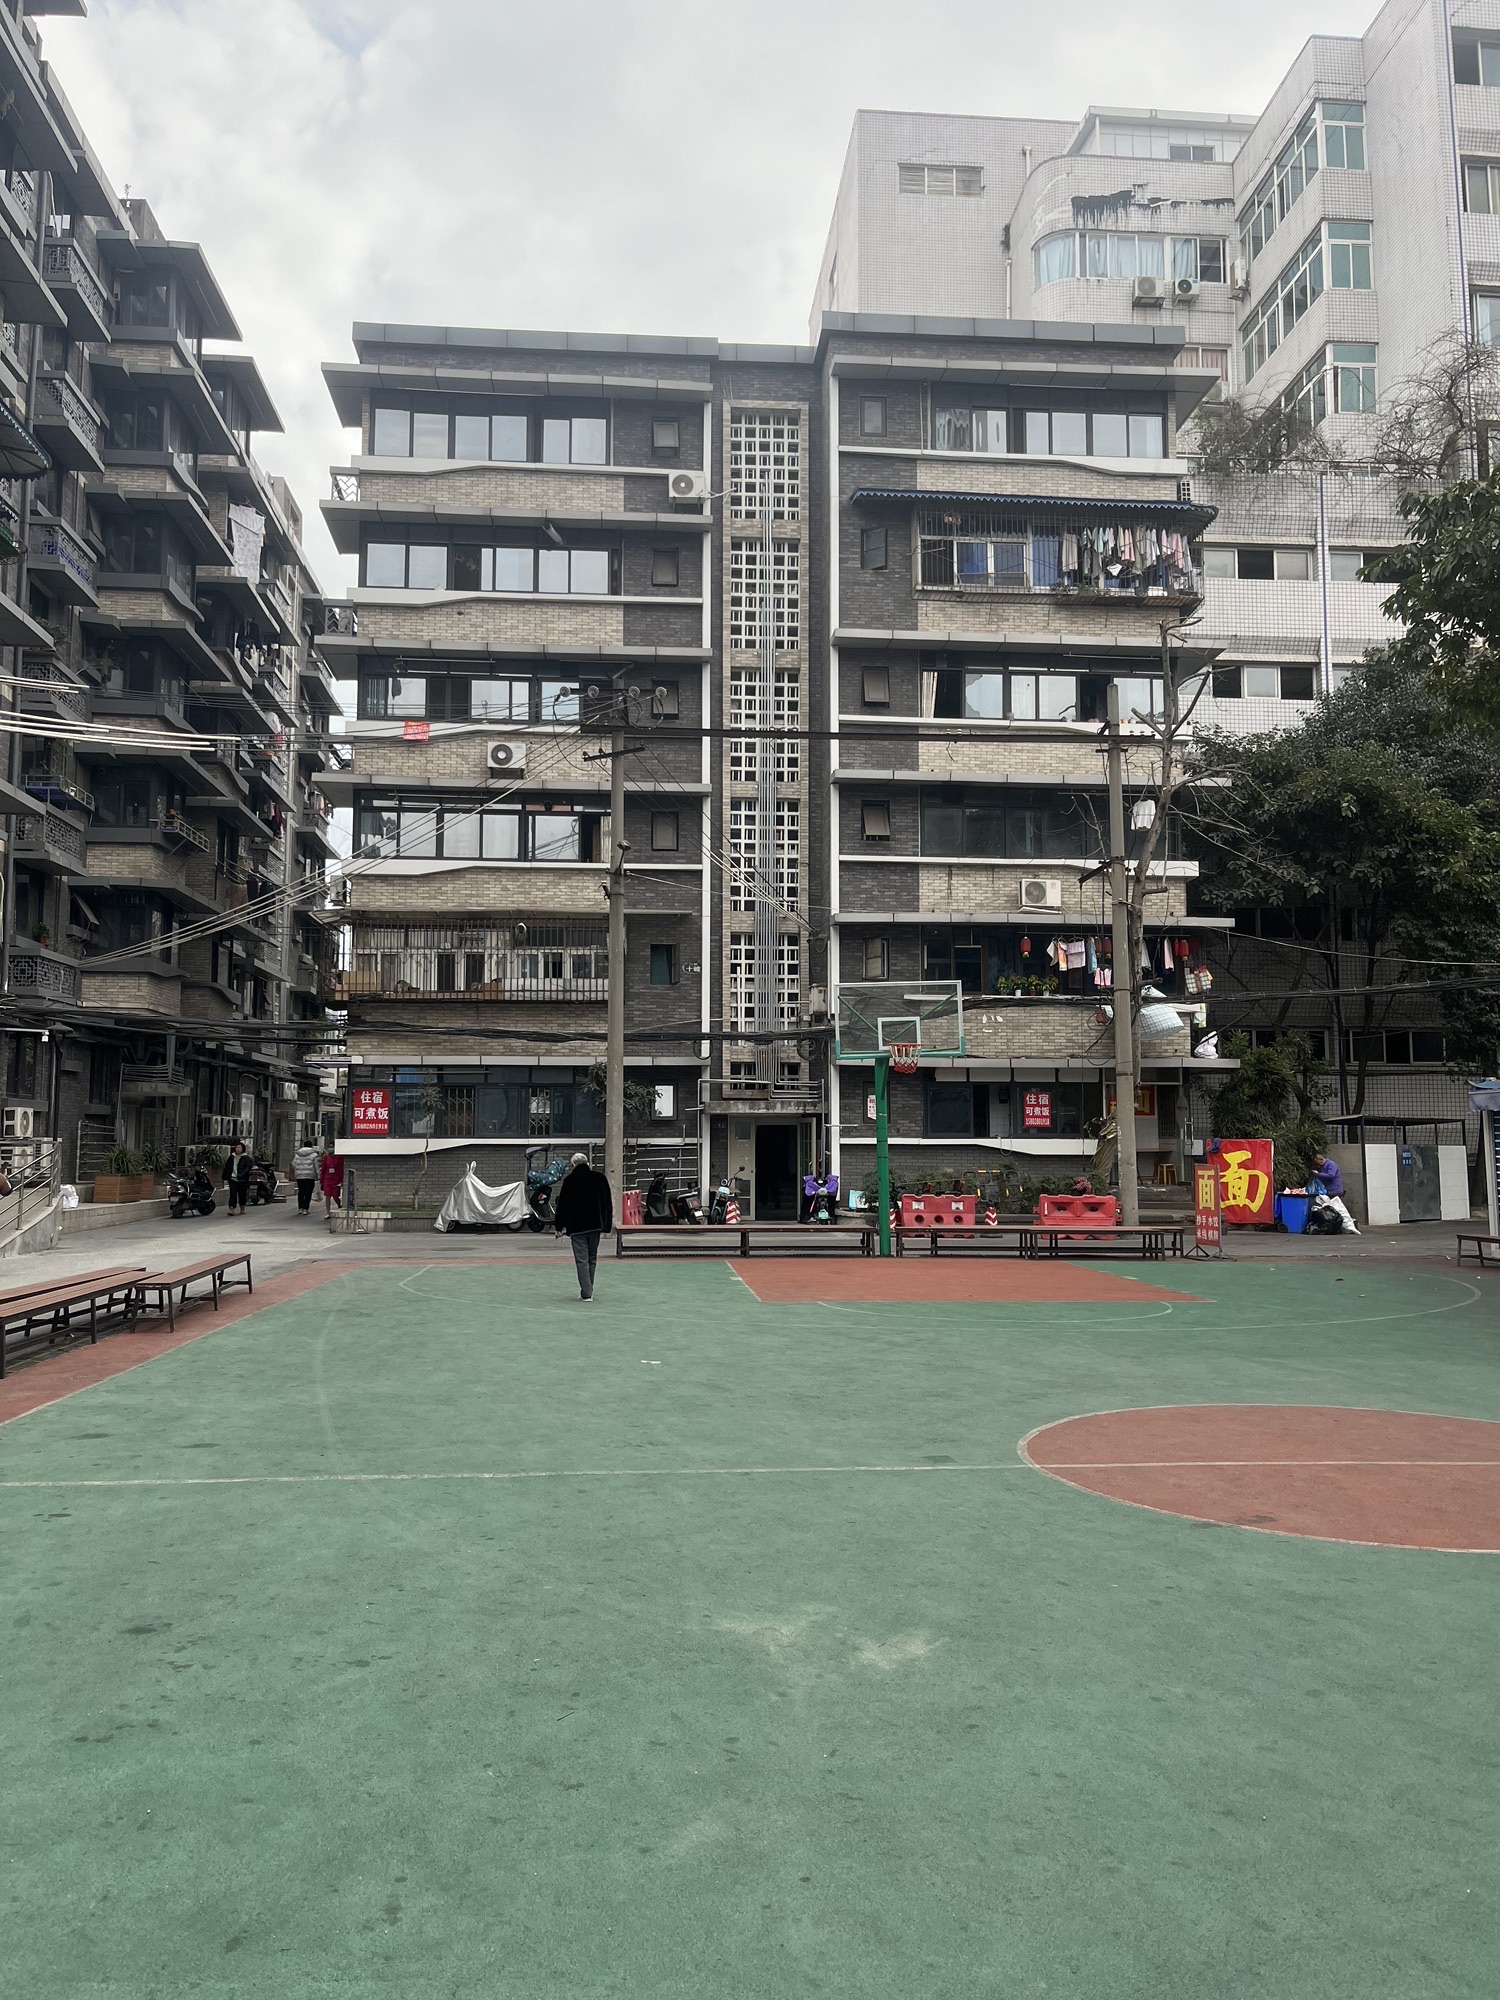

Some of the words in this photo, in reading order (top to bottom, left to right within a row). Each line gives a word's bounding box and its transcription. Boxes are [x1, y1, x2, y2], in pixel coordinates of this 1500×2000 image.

[360, 1090, 383, 1104] 住宿
[1025, 1093, 1049, 1105] 住宿
[354, 1107, 389, 1119] 可煮饭
[1025, 1106, 1050, 1116] 可煮饭
[1219, 1150, 1269, 1213] 面
[1197, 1169, 1215, 1211] 面
